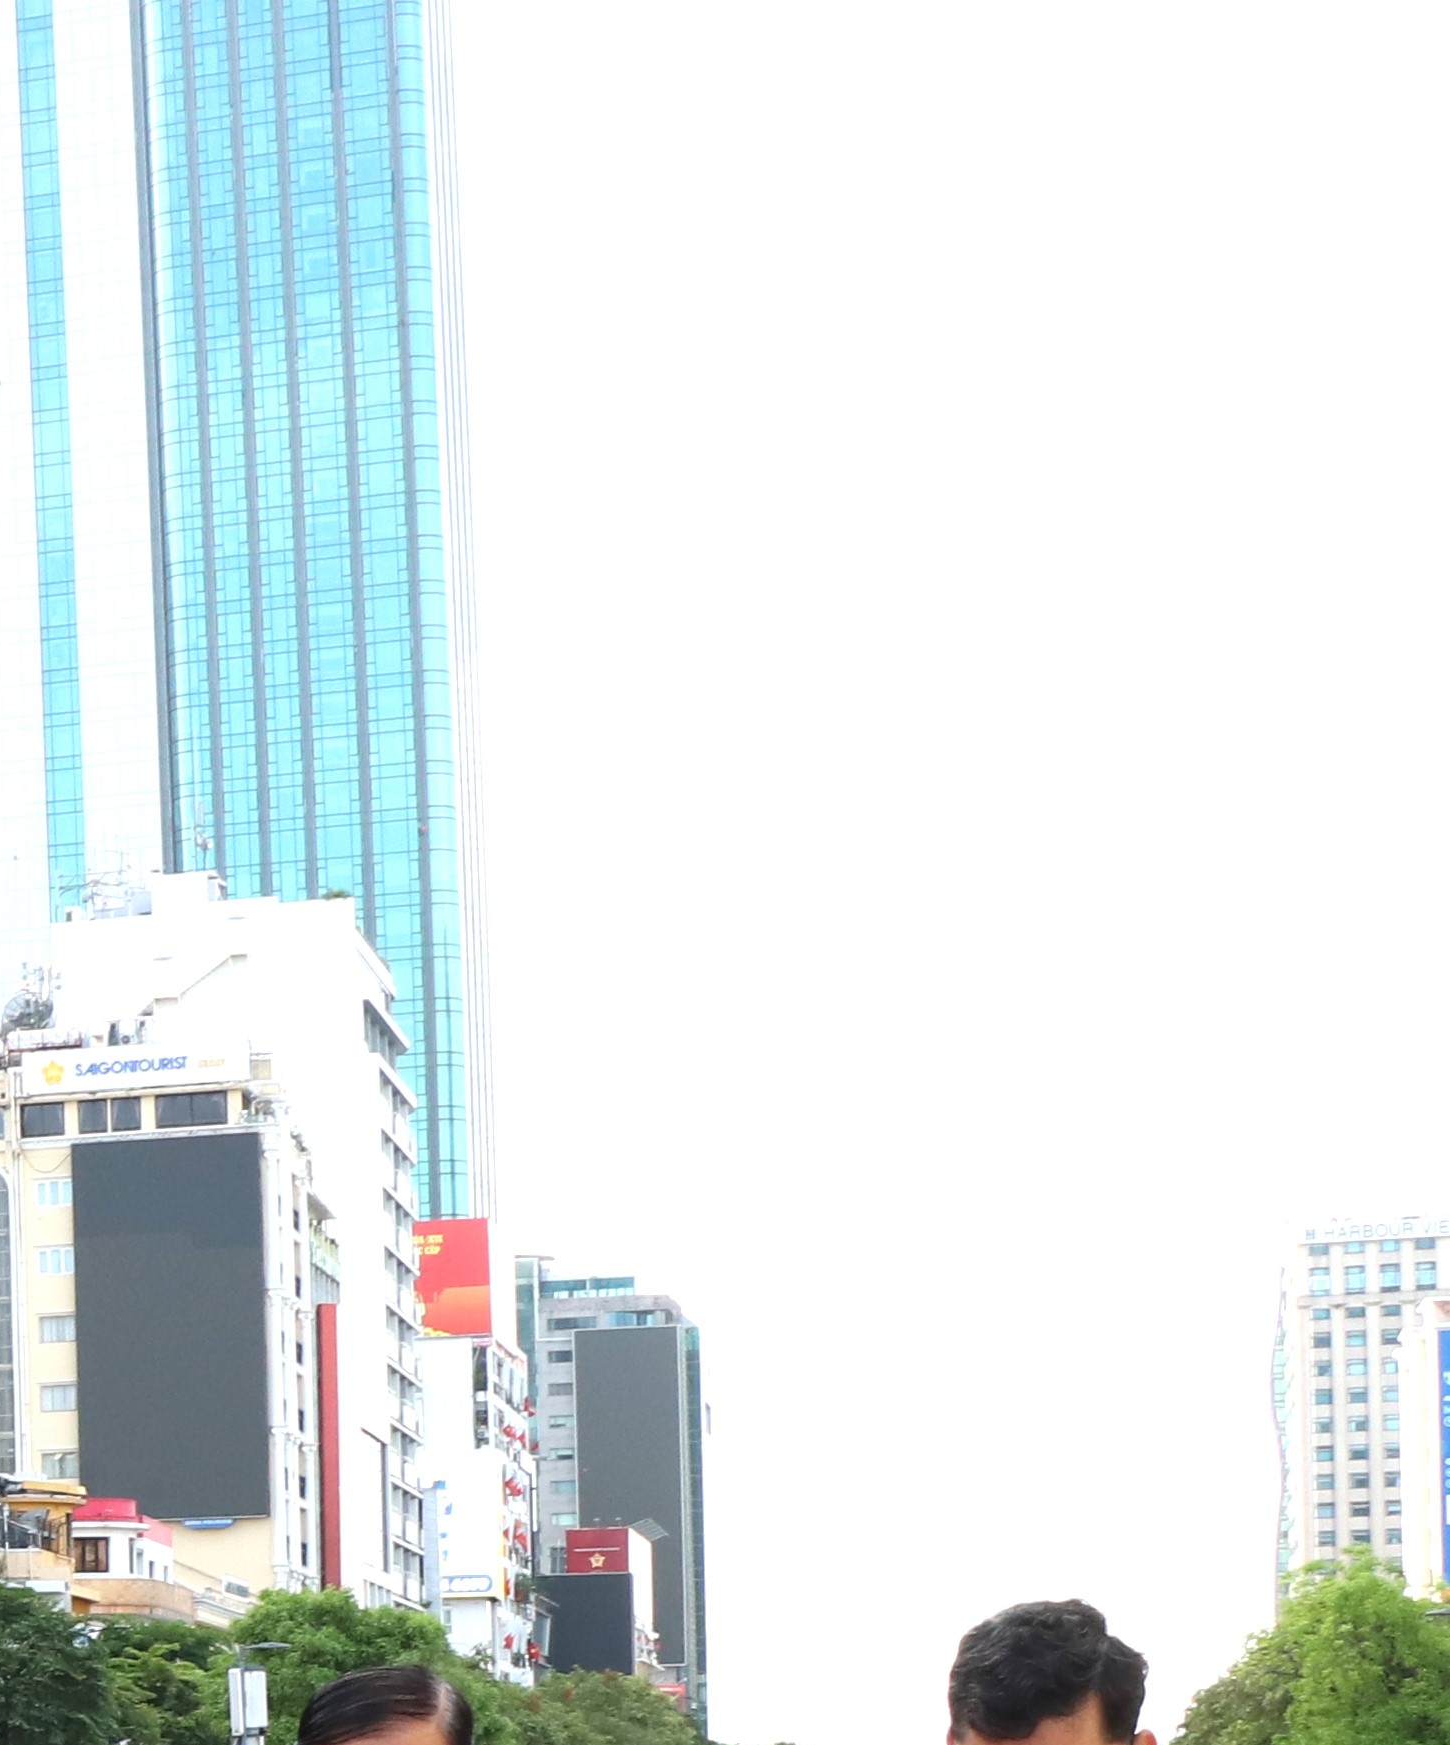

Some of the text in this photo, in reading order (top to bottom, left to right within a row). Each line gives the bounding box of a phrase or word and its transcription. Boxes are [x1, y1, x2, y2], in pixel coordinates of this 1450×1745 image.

[75, 1056, 188, 1076] SAIGONTOURIST
[1324, 1222, 1413, 1240] HARBOUR
[1422, 1220, 1450, 1235] VIE
